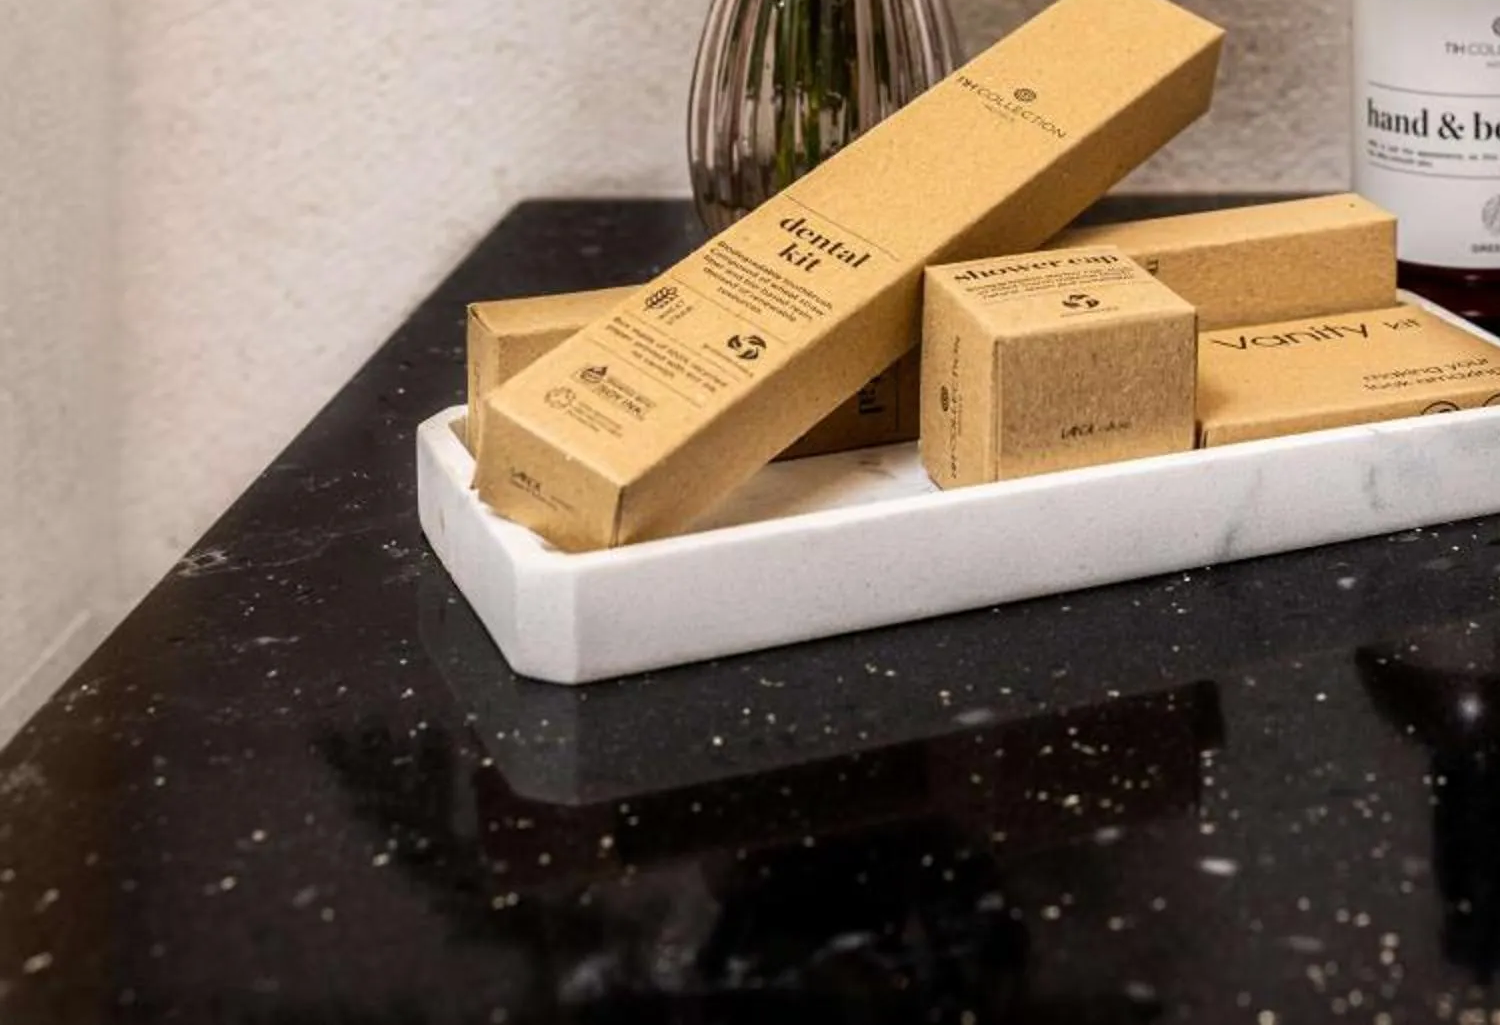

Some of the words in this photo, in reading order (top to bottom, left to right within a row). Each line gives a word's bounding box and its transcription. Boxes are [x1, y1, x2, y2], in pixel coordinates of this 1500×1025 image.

[977, 87, 1067, 139] COLLECTION
[1367, 98, 1429, 138] hand
[1437, 112, 1464, 140] &
[779, 243, 821, 272] kit
[780, 218, 871, 268] dental
[953, 259, 1062, 281] shower
[1068, 254, 1120, 266] cap
[1382, 318, 1421, 331] kit
[1362, 365, 1444, 381] making
[1444, 357, 1489, 371] your
